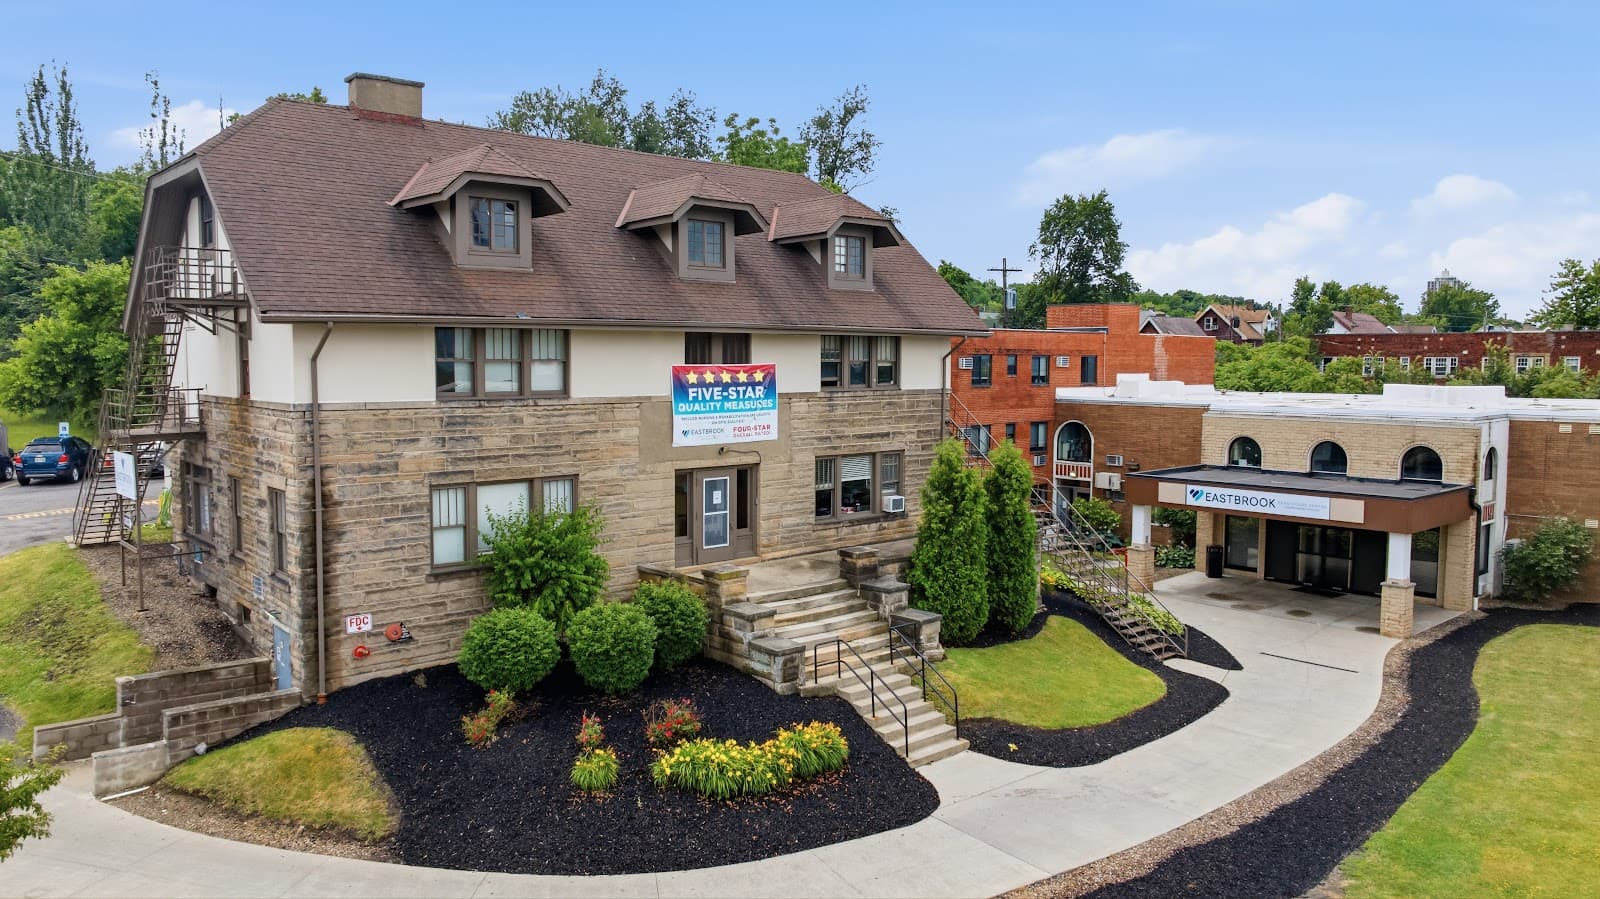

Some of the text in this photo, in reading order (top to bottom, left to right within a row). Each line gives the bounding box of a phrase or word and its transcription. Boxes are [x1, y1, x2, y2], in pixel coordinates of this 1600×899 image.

[688, 386, 765, 401] FIVE-STAR
[678, 399, 773, 412] QUALITY MEASURES
[1205, 492, 1276, 508] EASTBROOK
[349, 616, 369, 627] FDC
